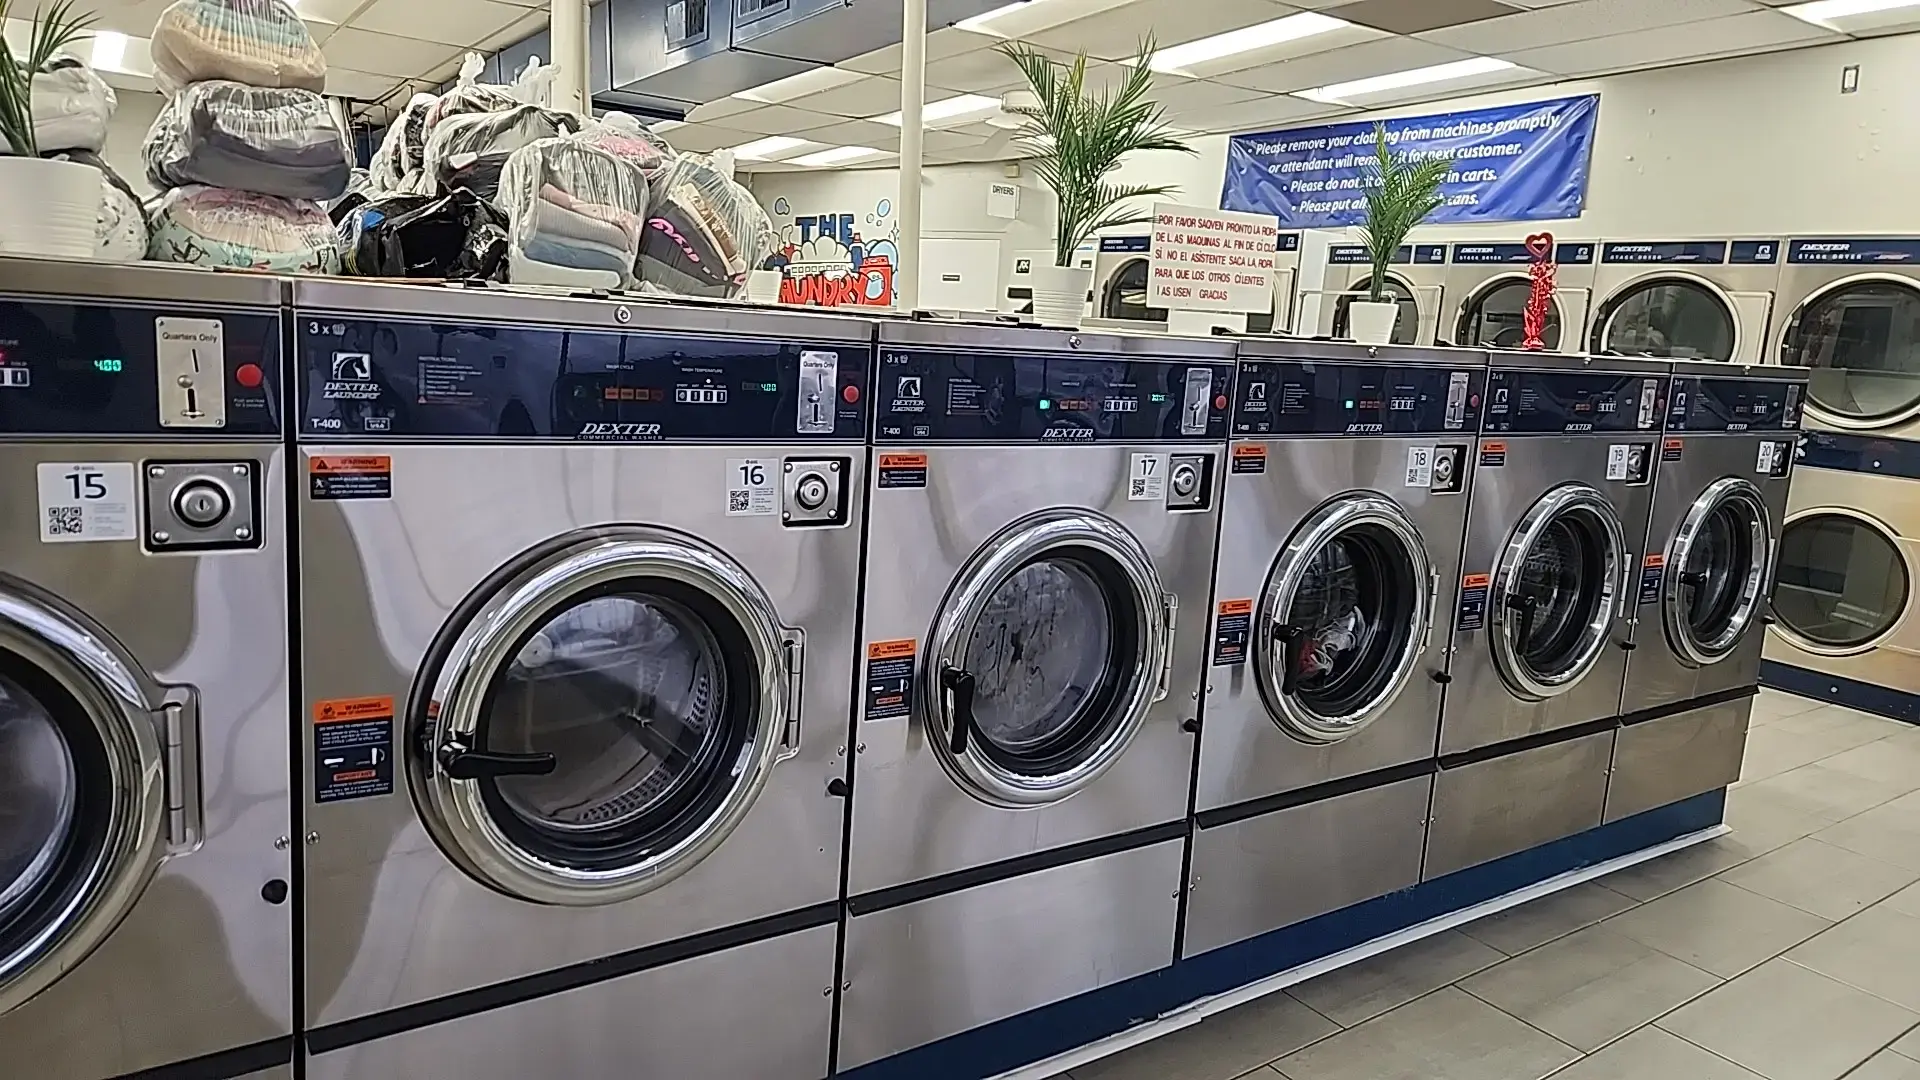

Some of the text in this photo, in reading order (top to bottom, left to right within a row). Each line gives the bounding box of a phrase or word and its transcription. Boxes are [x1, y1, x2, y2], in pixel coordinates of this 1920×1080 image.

[1256, 141, 1286, 155] Please
[1288, 138, 1326, 152] remove
[1327, 135, 1353, 150] your
[1401, 127, 1430, 141] from
[1432, 119, 1493, 139] machines
[1268, 164, 1280, 174] or
[1281, 157, 1333, 174] attendant
[1335, 154, 1354, 170] will
[1408, 148, 1426, 163] for
[1429, 146, 1457, 160] next
[1457, 142, 1523, 159] customer.
[1291, 179, 1323, 193] Please
[1325, 176, 1339, 191] do
[1340, 176, 1360, 190] not
[1447, 169, 1460, 183] in
[1462, 167, 1498, 183] carts.
[992, 184, 1015, 196] DRYERS
[1300, 199, 1331, 214] Please
[1332, 199, 1351, 214] put
[1351, 198, 1368, 210] all
[1447, 193, 1479, 206] cans.
[795, 213, 855, 249] THE
[1159, 214, 1174, 225] POR
[1175, 216, 1197, 228] FAVOR
[1226, 222, 1253, 235] PRONTO
[1253, 225, 1260, 235] LA
[1262, 226, 1277, 237] ROPA
[1156, 231, 1166, 242] DE
[1187, 235, 1221, 248] MAQUINAS
[1223, 239, 1232, 249] AL
[1234, 239, 1245, 250] FIN
[1246, 240, 1255, 251] DE
[1800, 243, 1851, 251] DEXTER
[1167, 249, 1178, 260] NO
[1229, 255, 1246, 266] SACA
[1258, 258, 1274, 269] ROPA
[1154, 267, 1173, 279] PARA
[1175, 269, 1190, 280] QUE
[1191, 270, 1205, 281] LOS
[1208, 272, 1231, 283] OTROS
[779, 273, 871, 307] AUNDRY
[1172, 286, 1192, 298] USEN
[1199, 288, 1228, 300] GRACIAS
[309, 321, 330, 335] 3 x
[162, 331, 218, 344] Quarters Only
[886, 353, 893, 364] 3
[324, 382, 380, 392] DEXTER
[311, 418, 341, 429] T-400
[579, 422, 661, 435] DEXTER
[1346, 423, 1383, 432] DEXTER
[1565, 423, 1593, 431] DEXTER
[1726, 423, 1748, 431] DEXTER
[883, 427, 901, 435] T-400
[1041, 428, 1094, 438] DEXTER
[1614, 449, 1624, 462] 19
[1761, 445, 1772, 457] 20
[1414, 452, 1427, 466] 18
[1140, 459, 1158, 476] 17
[740, 465, 765, 486] 16
[65, 473, 107, 500] 15
